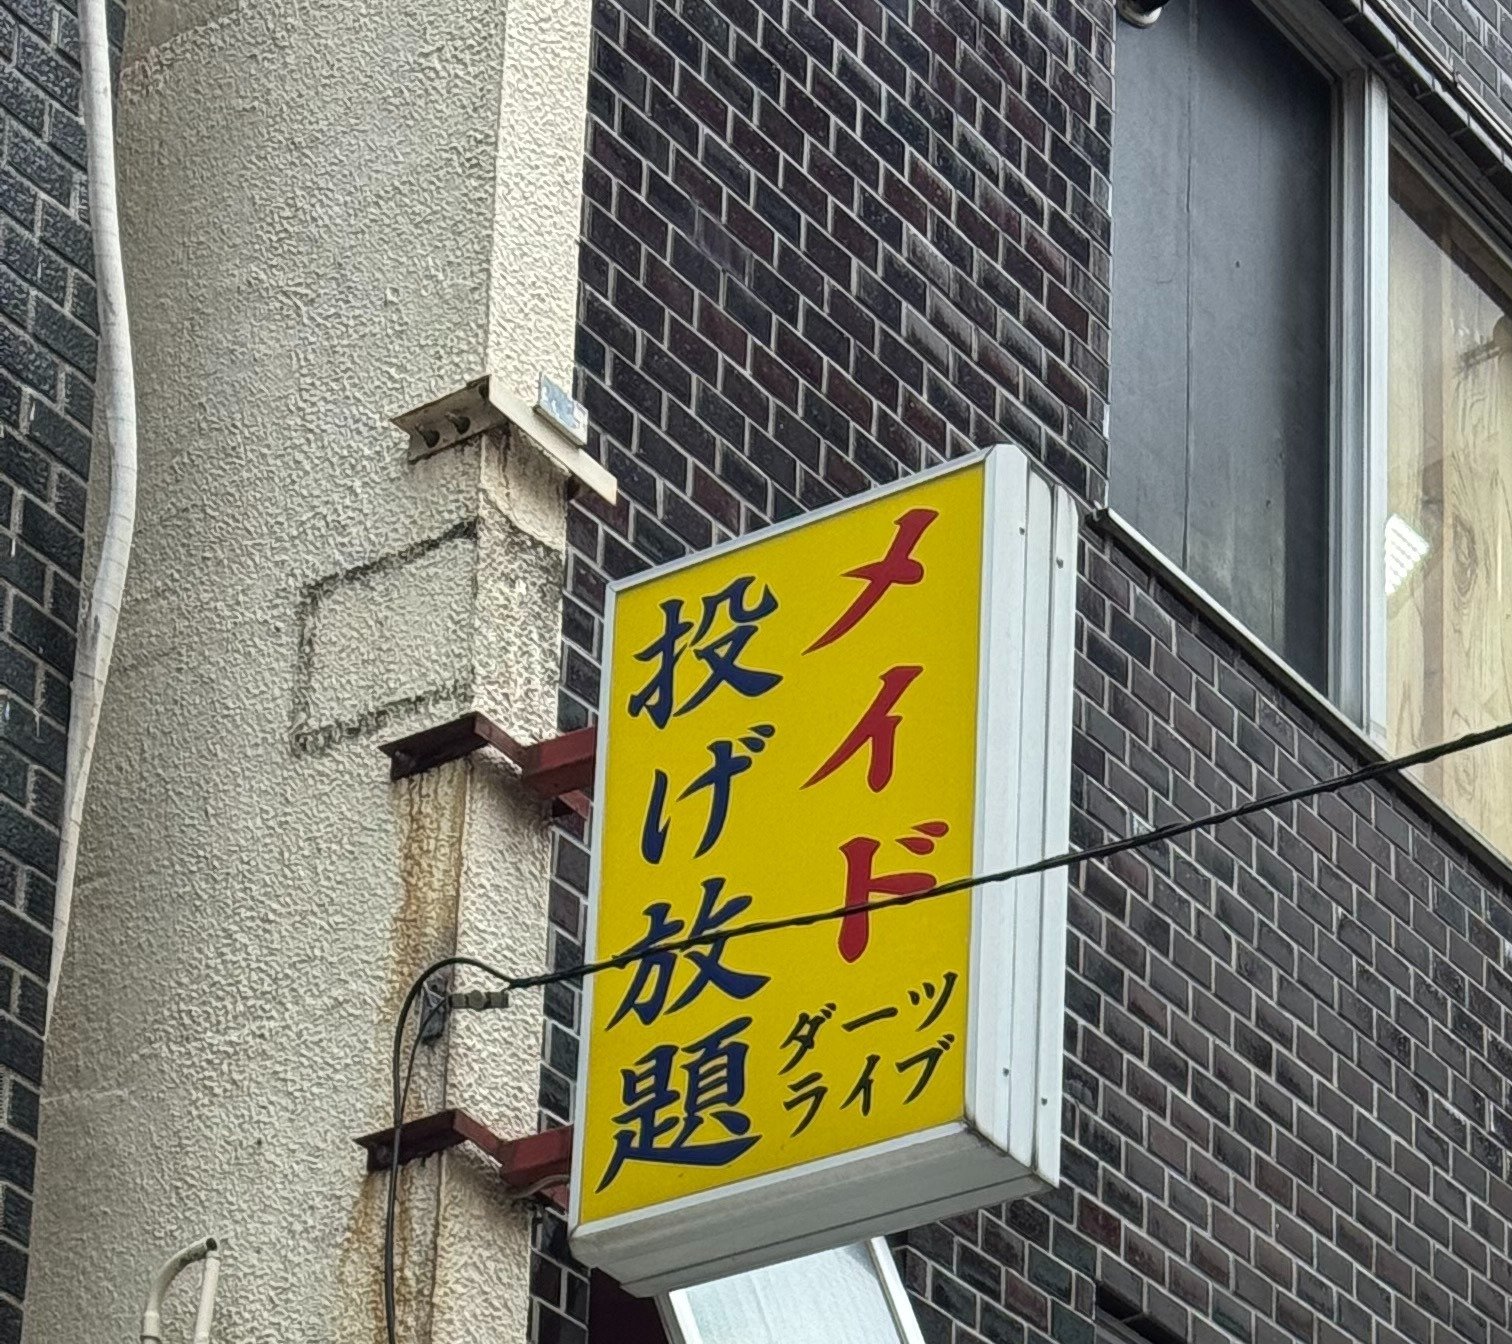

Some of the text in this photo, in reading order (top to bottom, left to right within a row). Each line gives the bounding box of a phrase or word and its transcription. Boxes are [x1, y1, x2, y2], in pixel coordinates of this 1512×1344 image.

[802, 508, 949, 964] メイド
[596, 576, 781, 1195] 投げ放題
[778, 971, 958, 1076] ダーツ
[782, 1033, 956, 1137] ライブ
